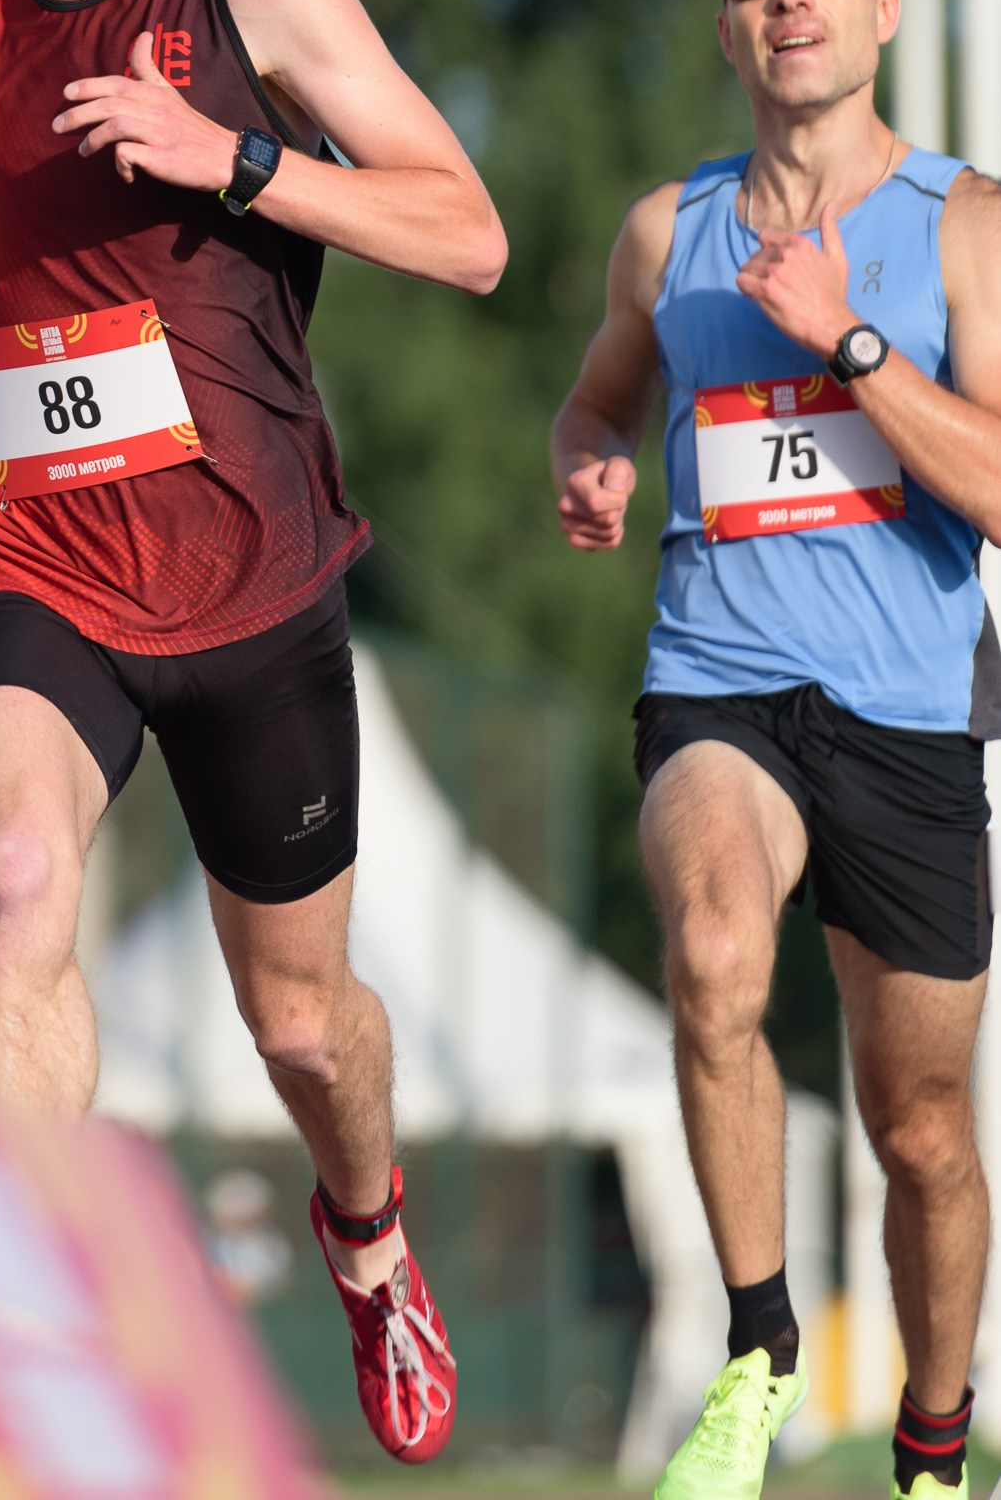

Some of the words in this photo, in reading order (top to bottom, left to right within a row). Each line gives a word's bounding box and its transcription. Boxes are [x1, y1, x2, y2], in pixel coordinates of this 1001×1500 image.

[38, 375, 102, 435] 88
[47, 462, 77, 481] 3000
[79, 454, 126, 476] метров
[761, 429, 819, 483] 75
[758, 507, 788, 526] 3000
[790, 504, 836, 523] метров
